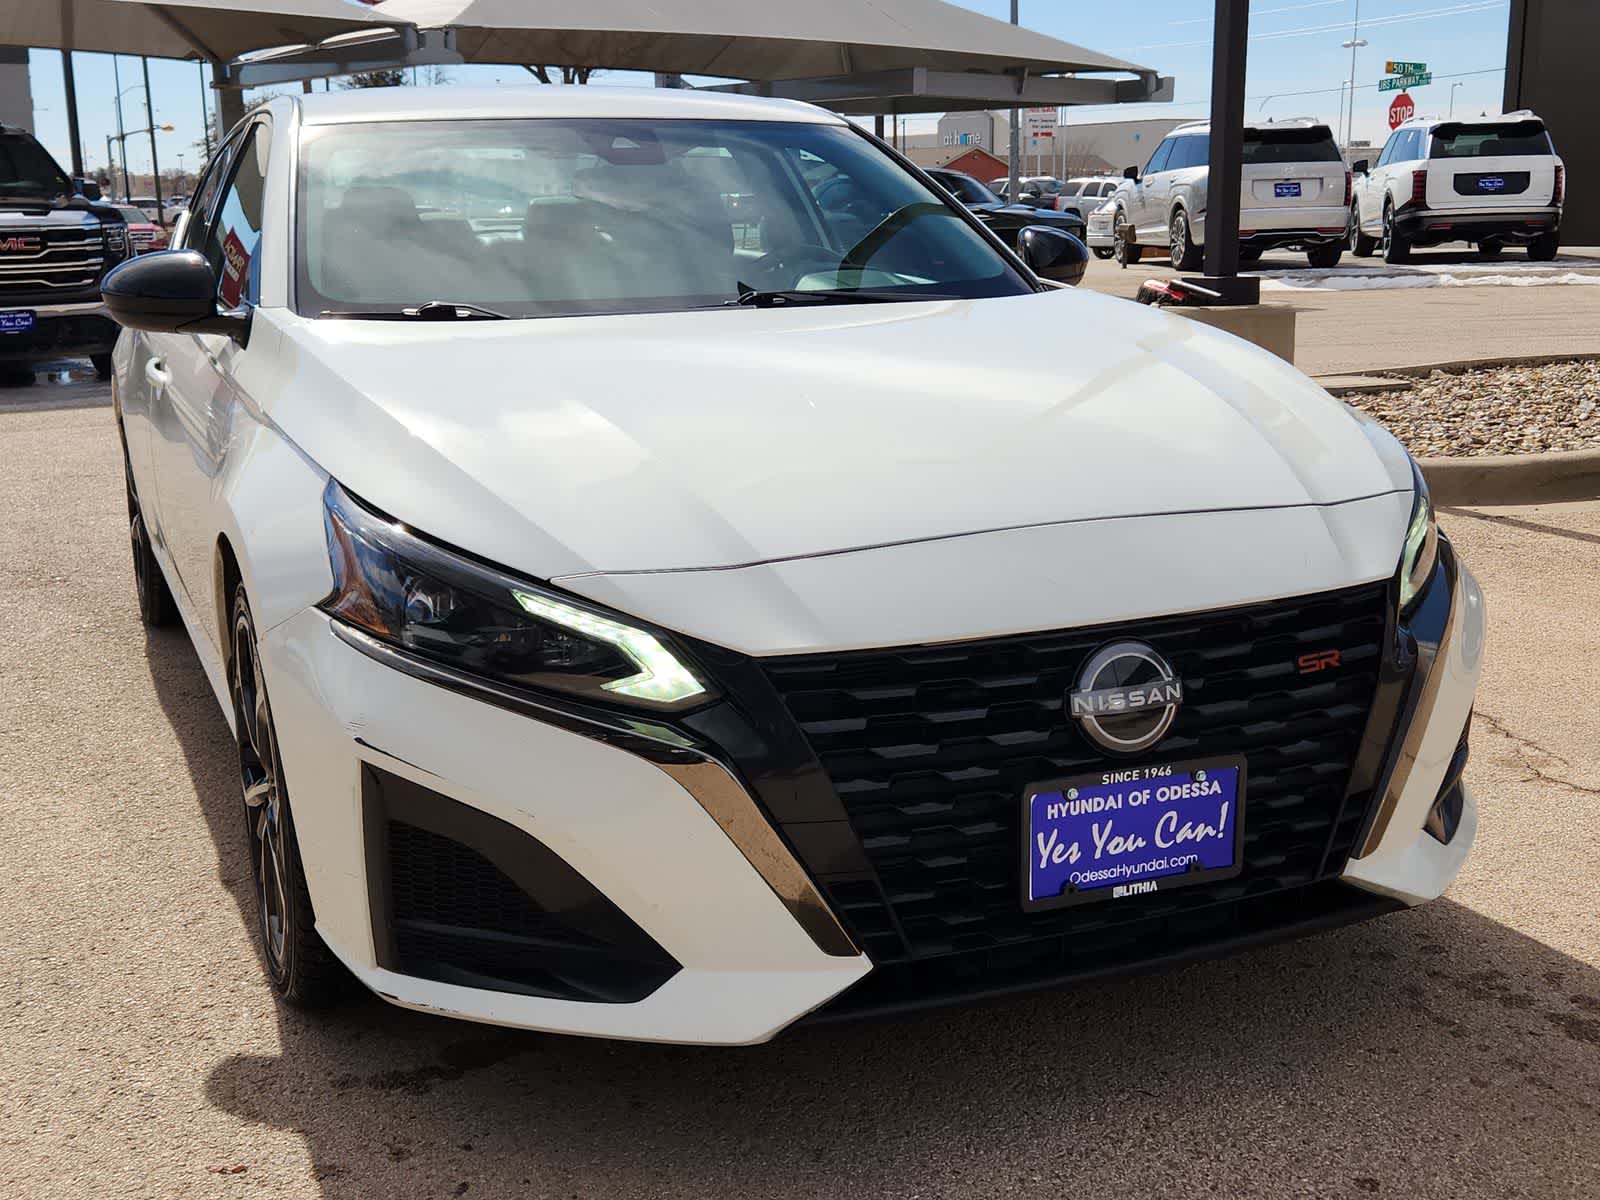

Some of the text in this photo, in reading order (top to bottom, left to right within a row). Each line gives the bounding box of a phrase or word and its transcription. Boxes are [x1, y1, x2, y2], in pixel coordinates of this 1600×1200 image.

[1393, 64, 1414, 73] 50TH
[1390, 105, 1413, 123] STOP
[944, 132, 953, 144] at
[1298, 649, 1341, 673] SR
[1073, 682, 1181, 715] NISSAN
[1102, 765, 1172, 785] SINCE 1946
[1046, 780, 1222, 820] HYUNDAI OF ODESSA
[1037, 802, 1230, 869] Yes You Can!
[1069, 853, 1198, 885] OdessaHyundai.com
[1122, 880, 1158, 898] LITHIA
